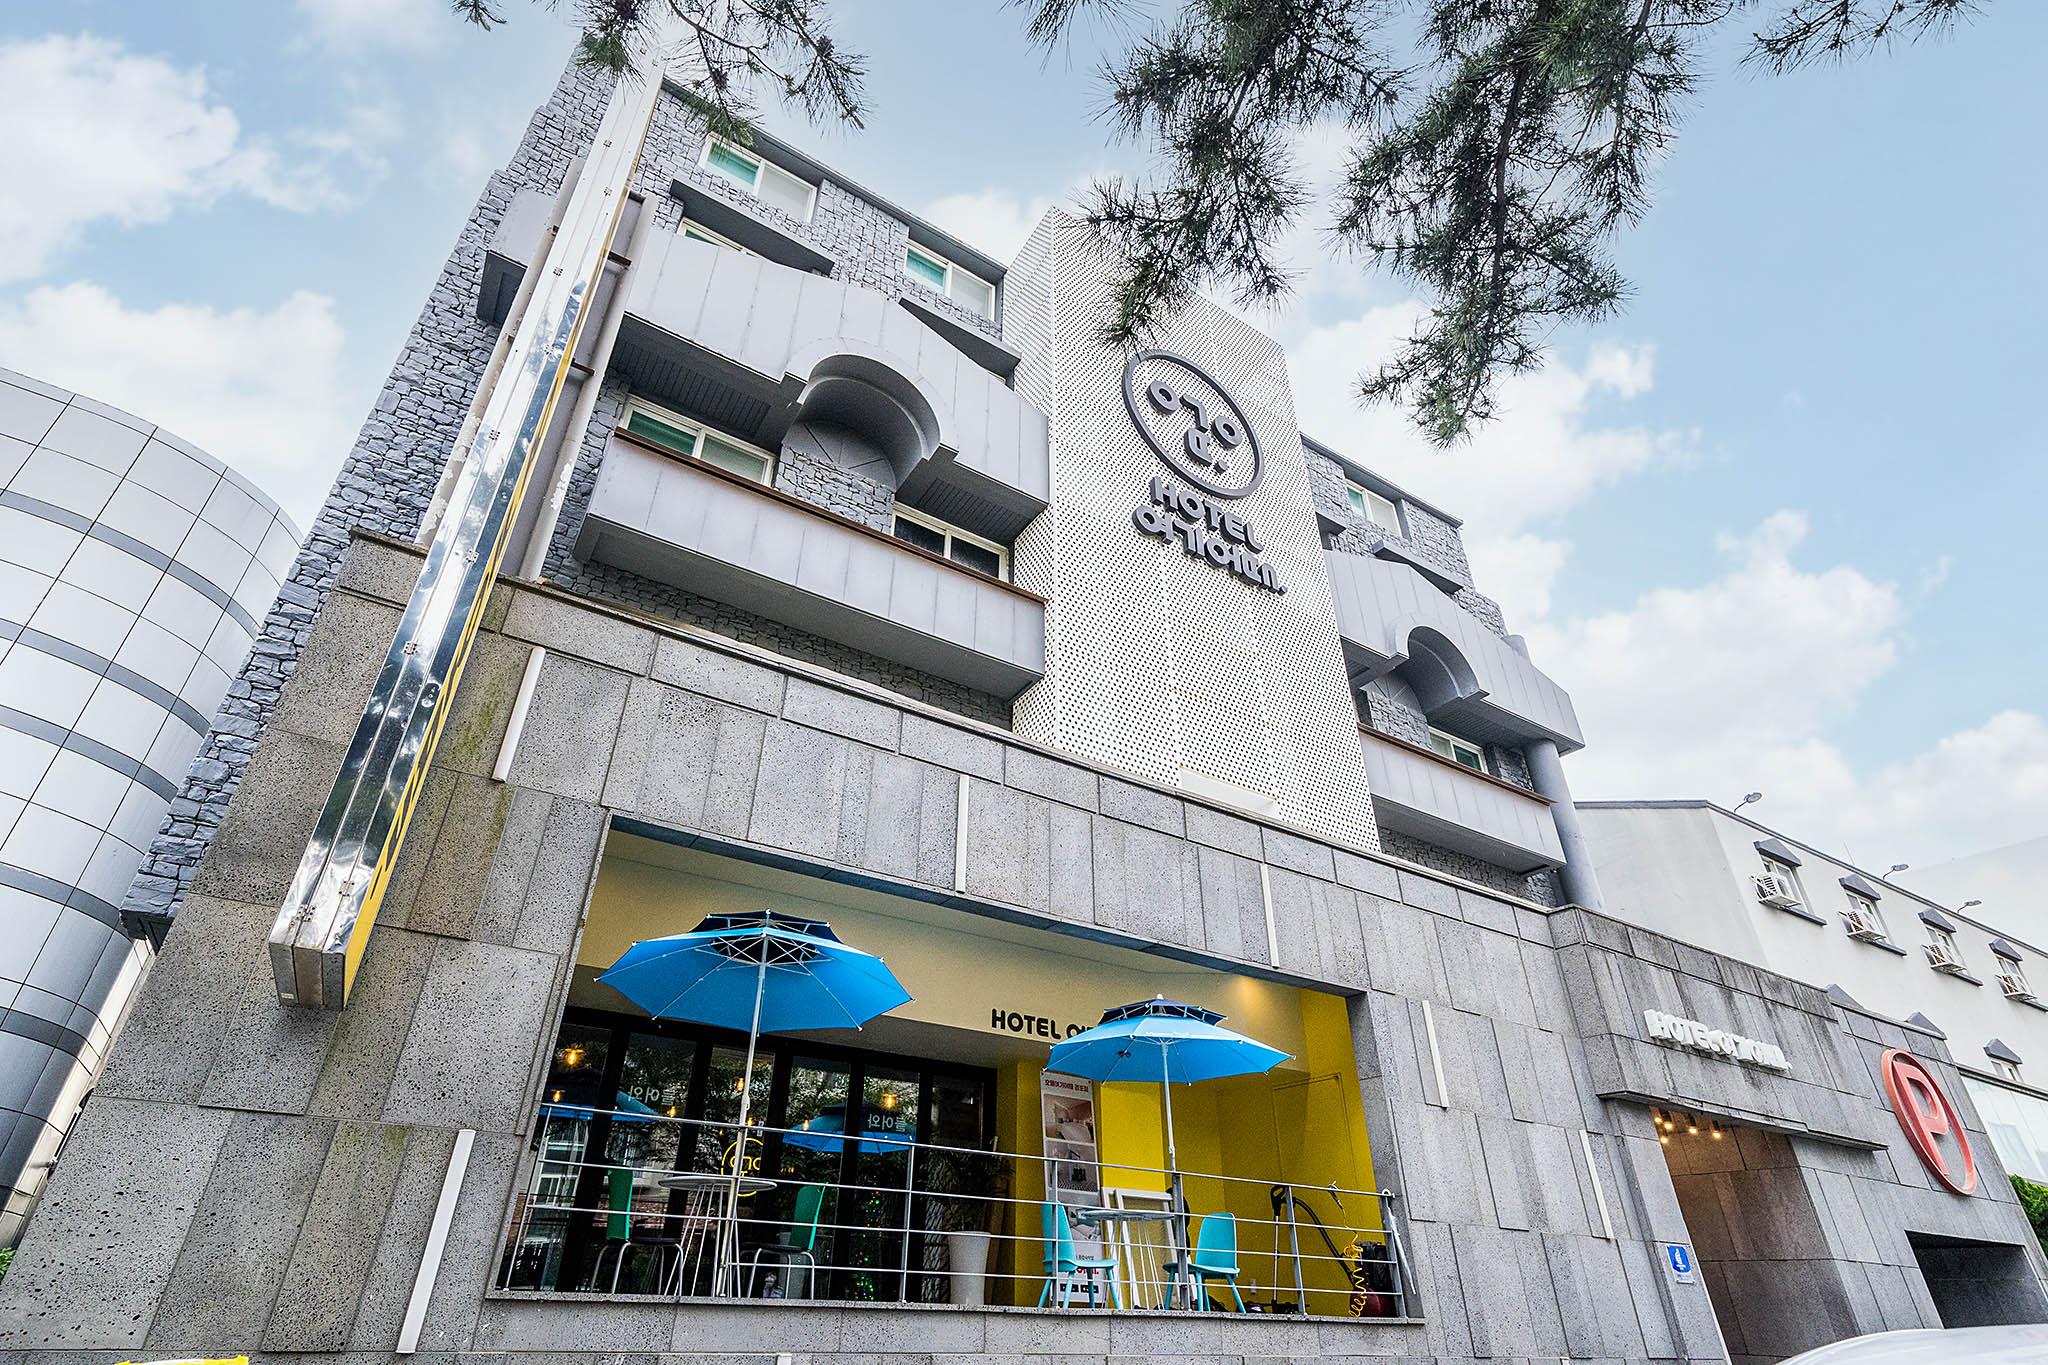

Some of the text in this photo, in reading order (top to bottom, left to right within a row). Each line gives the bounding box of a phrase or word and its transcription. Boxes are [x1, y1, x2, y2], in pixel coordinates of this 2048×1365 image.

[1150, 476, 1264, 554] HOTEL
[992, 1008, 1062, 1040] HOTEL
[1890, 1059, 1950, 1177] P
